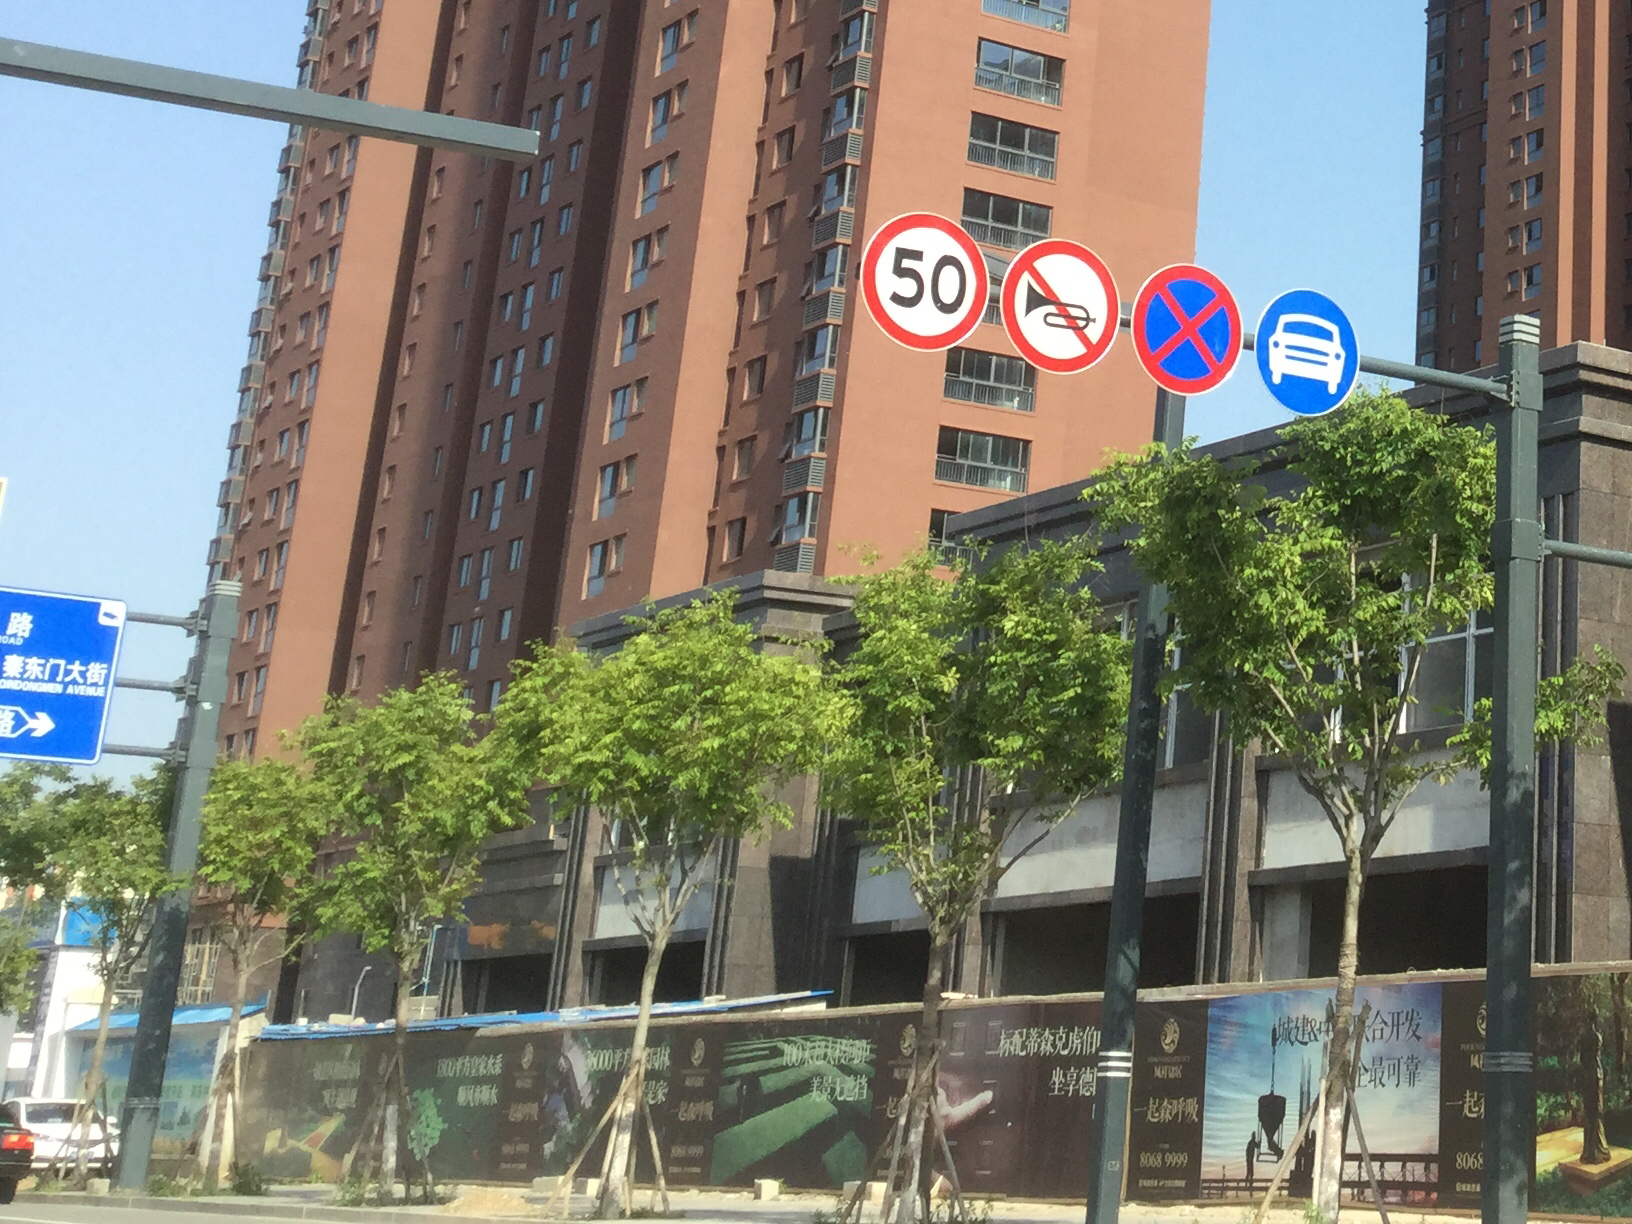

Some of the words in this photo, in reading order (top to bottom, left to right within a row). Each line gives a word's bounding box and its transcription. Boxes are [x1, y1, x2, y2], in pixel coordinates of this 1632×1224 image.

[889, 247, 966, 315] 50
[6, 612, 33, 638] 路
[3, 654, 108, 686] 秦东门大街
[66, 684, 106, 697] AVENUE
[998, 1026, 1101, 1057] 标配蒂森克虏伯
[1048, 1066, 1098, 1097] 坐享德
[1134, 1097, 1199, 1123] 一起森呼吸
